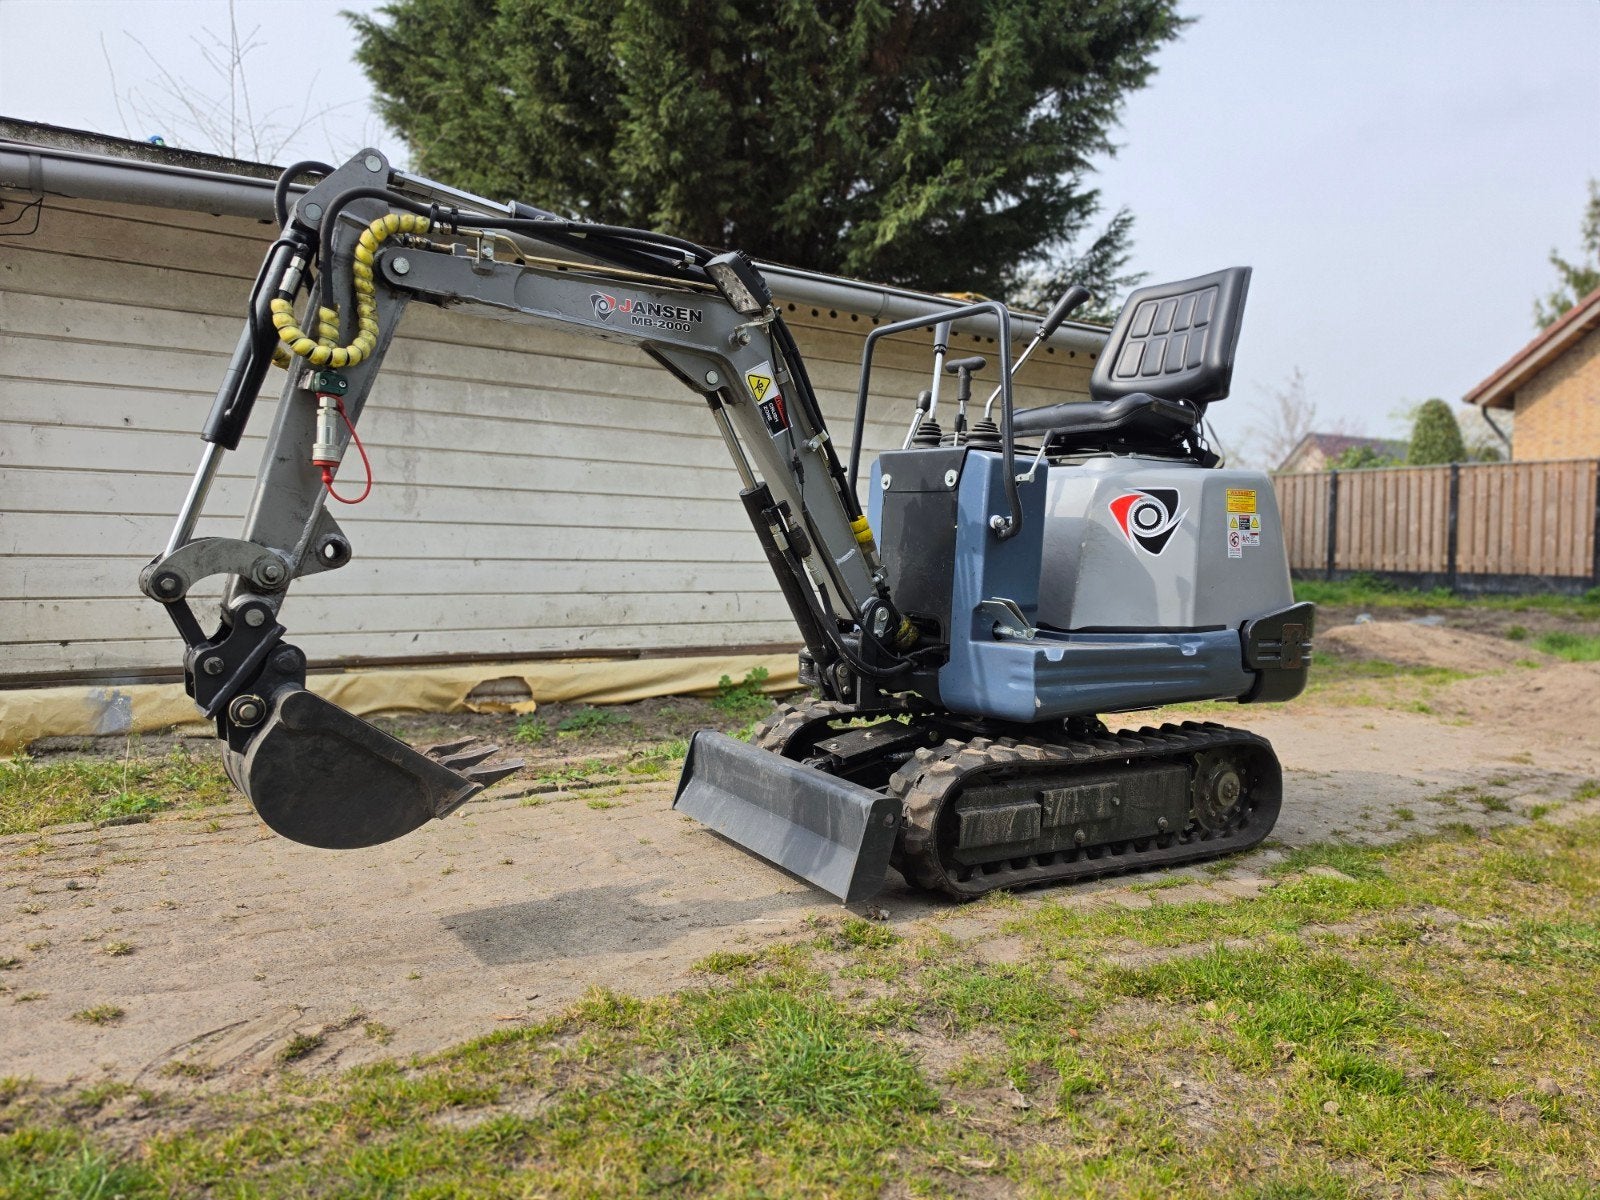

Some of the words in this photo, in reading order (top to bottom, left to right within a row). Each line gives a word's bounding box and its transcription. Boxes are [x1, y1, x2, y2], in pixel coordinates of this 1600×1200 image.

[619, 299, 702, 322] JANSEN
[631, 316, 691, 332] MB-2000
[763, 405, 773, 422] ZONE
